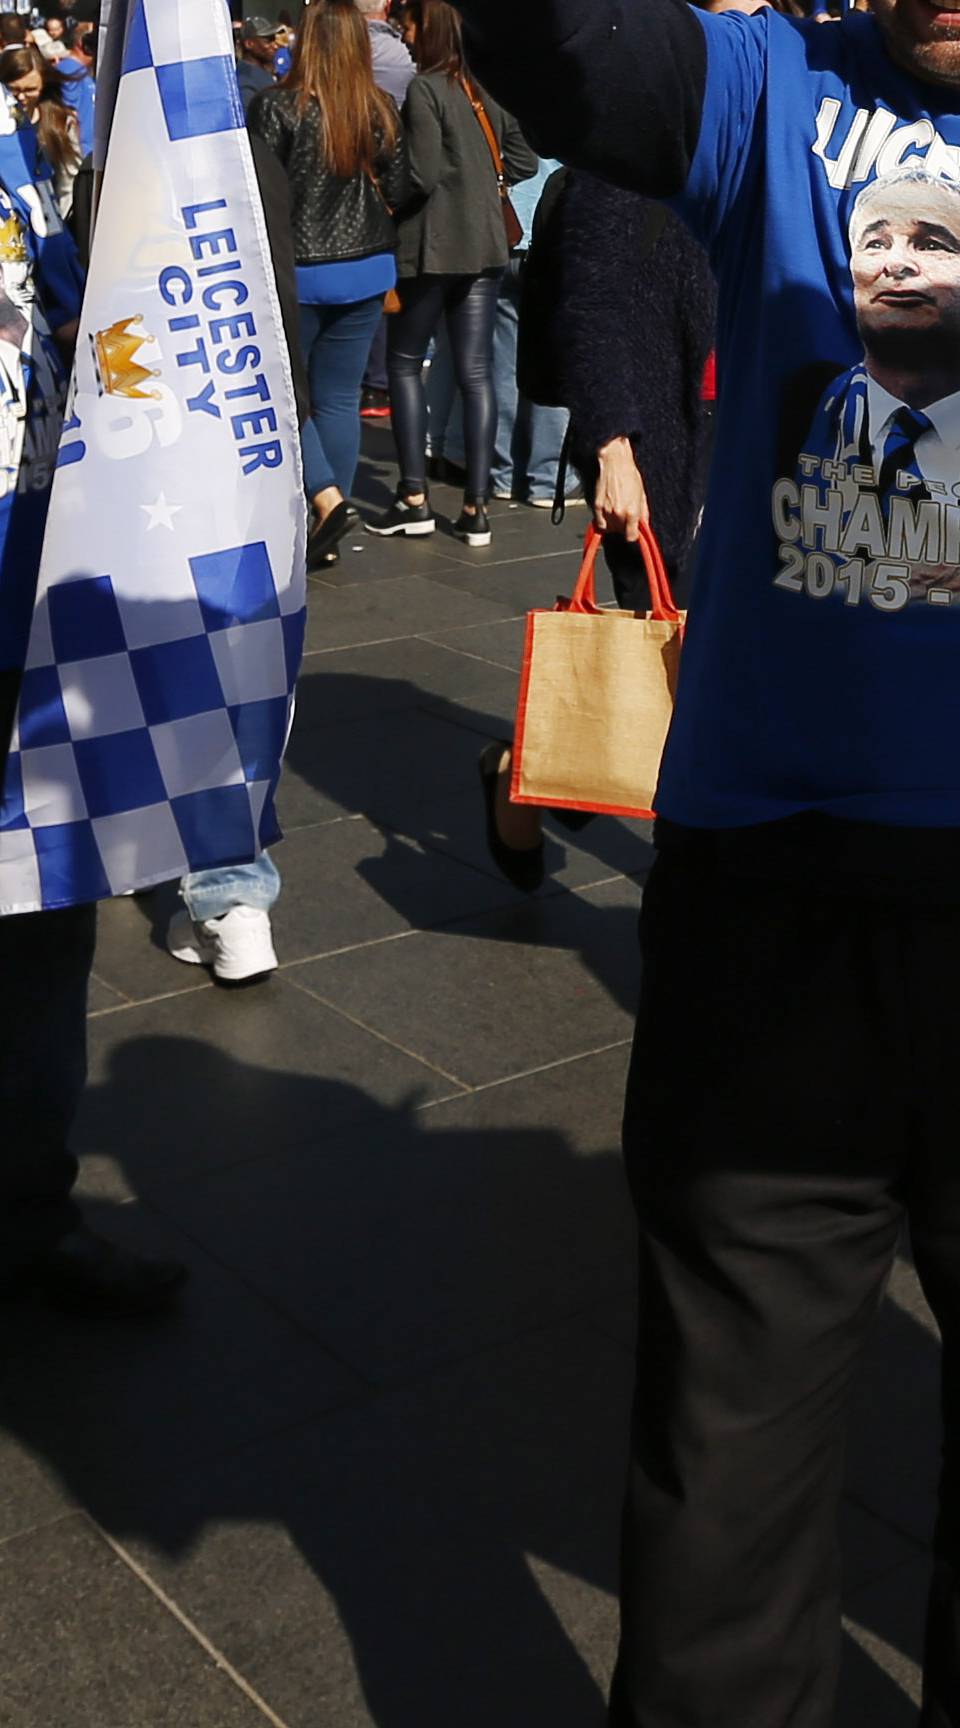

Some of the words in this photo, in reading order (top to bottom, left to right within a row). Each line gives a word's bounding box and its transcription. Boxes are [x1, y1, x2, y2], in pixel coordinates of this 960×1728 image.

[158, 265, 221, 419] CITY
[181, 198, 283, 476] LEICESTER
[799, 453, 877, 486] THE
[773, 544, 912, 611] 2015
